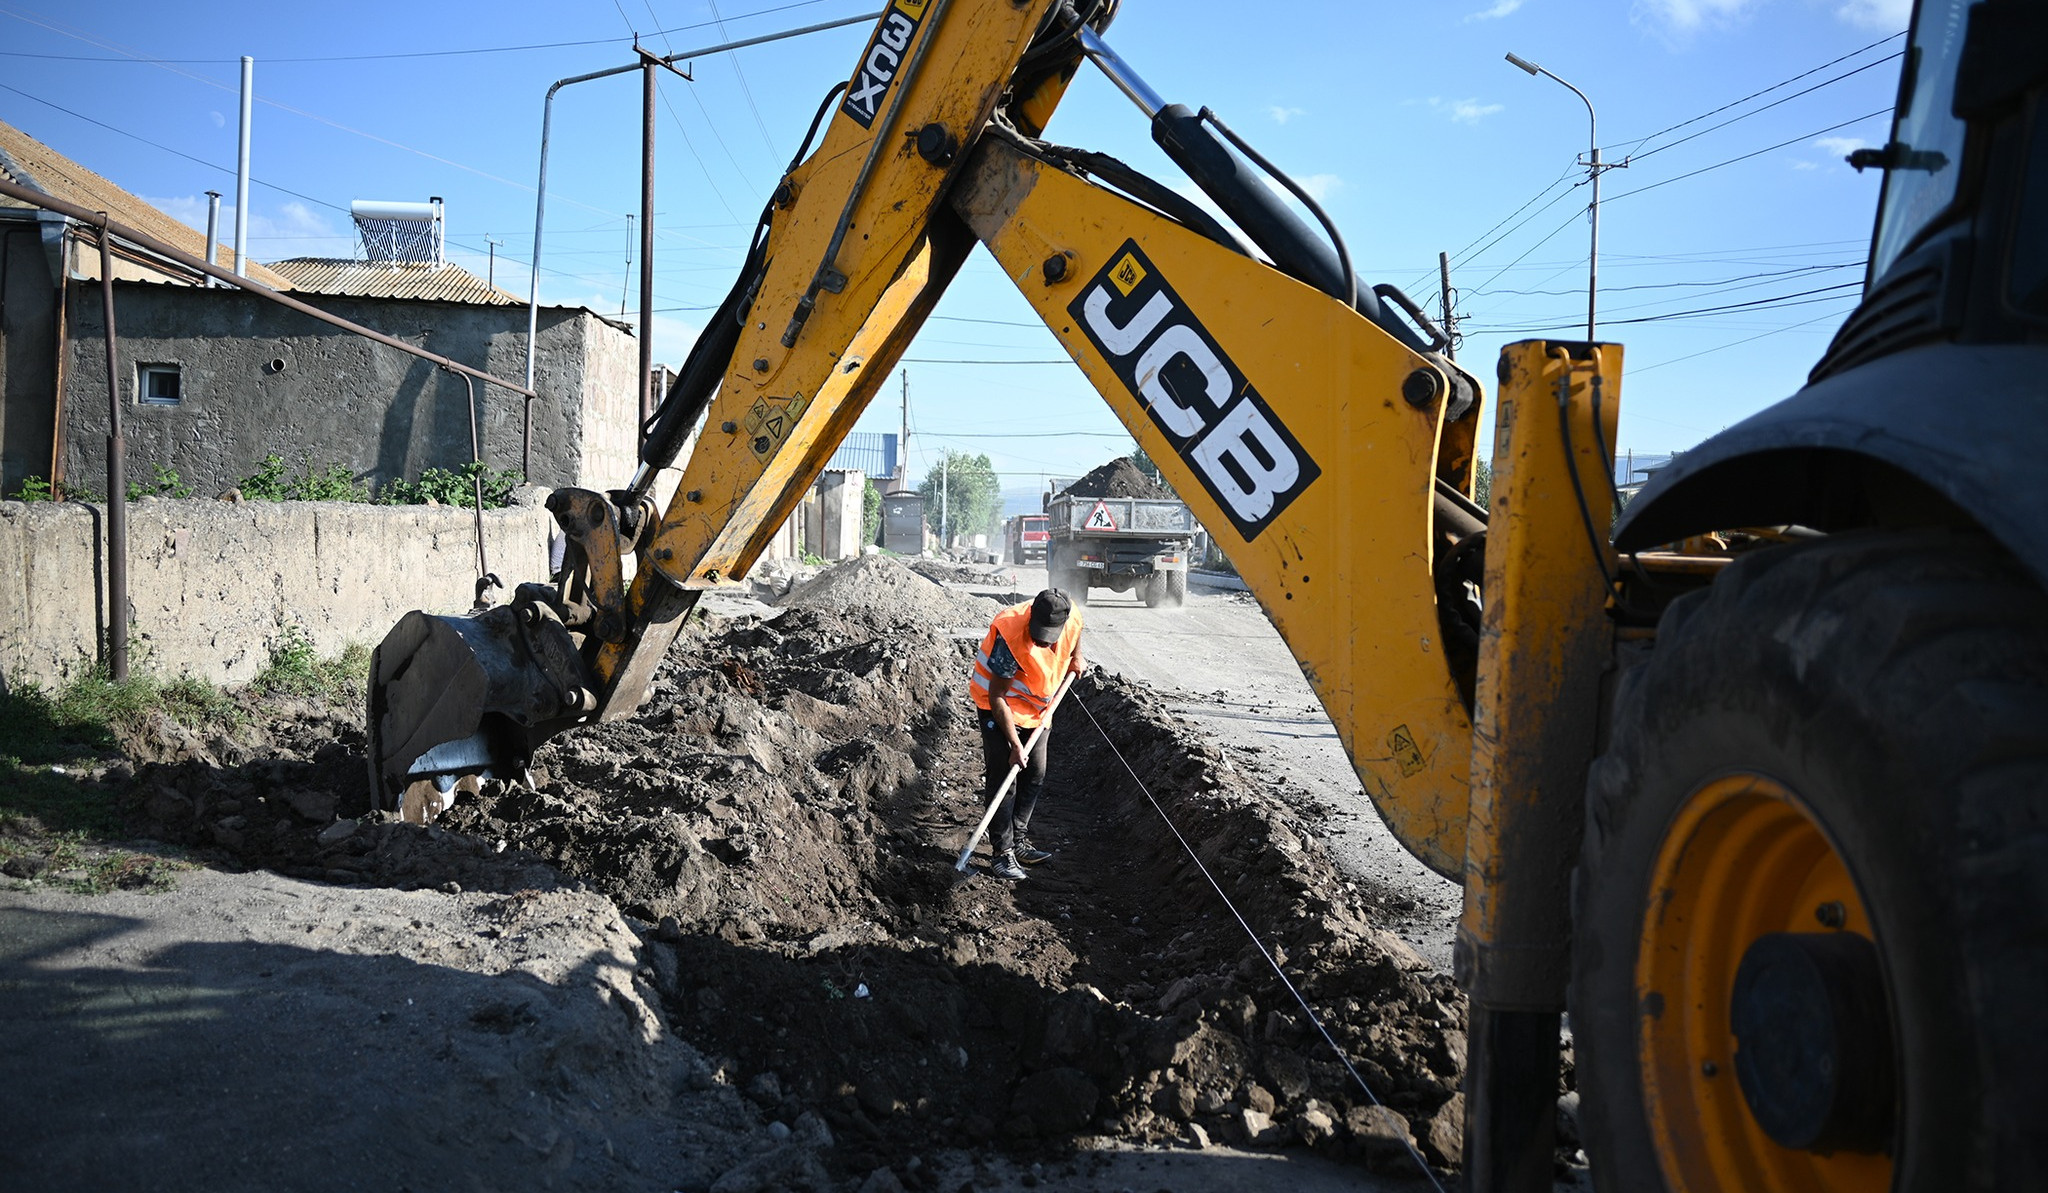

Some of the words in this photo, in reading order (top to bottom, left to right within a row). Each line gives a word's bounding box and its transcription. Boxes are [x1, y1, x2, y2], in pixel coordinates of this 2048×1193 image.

[849, 12, 913, 115] 3CX
[1120, 263, 1136, 284] JCB
[1083, 283, 1300, 523] JCB
